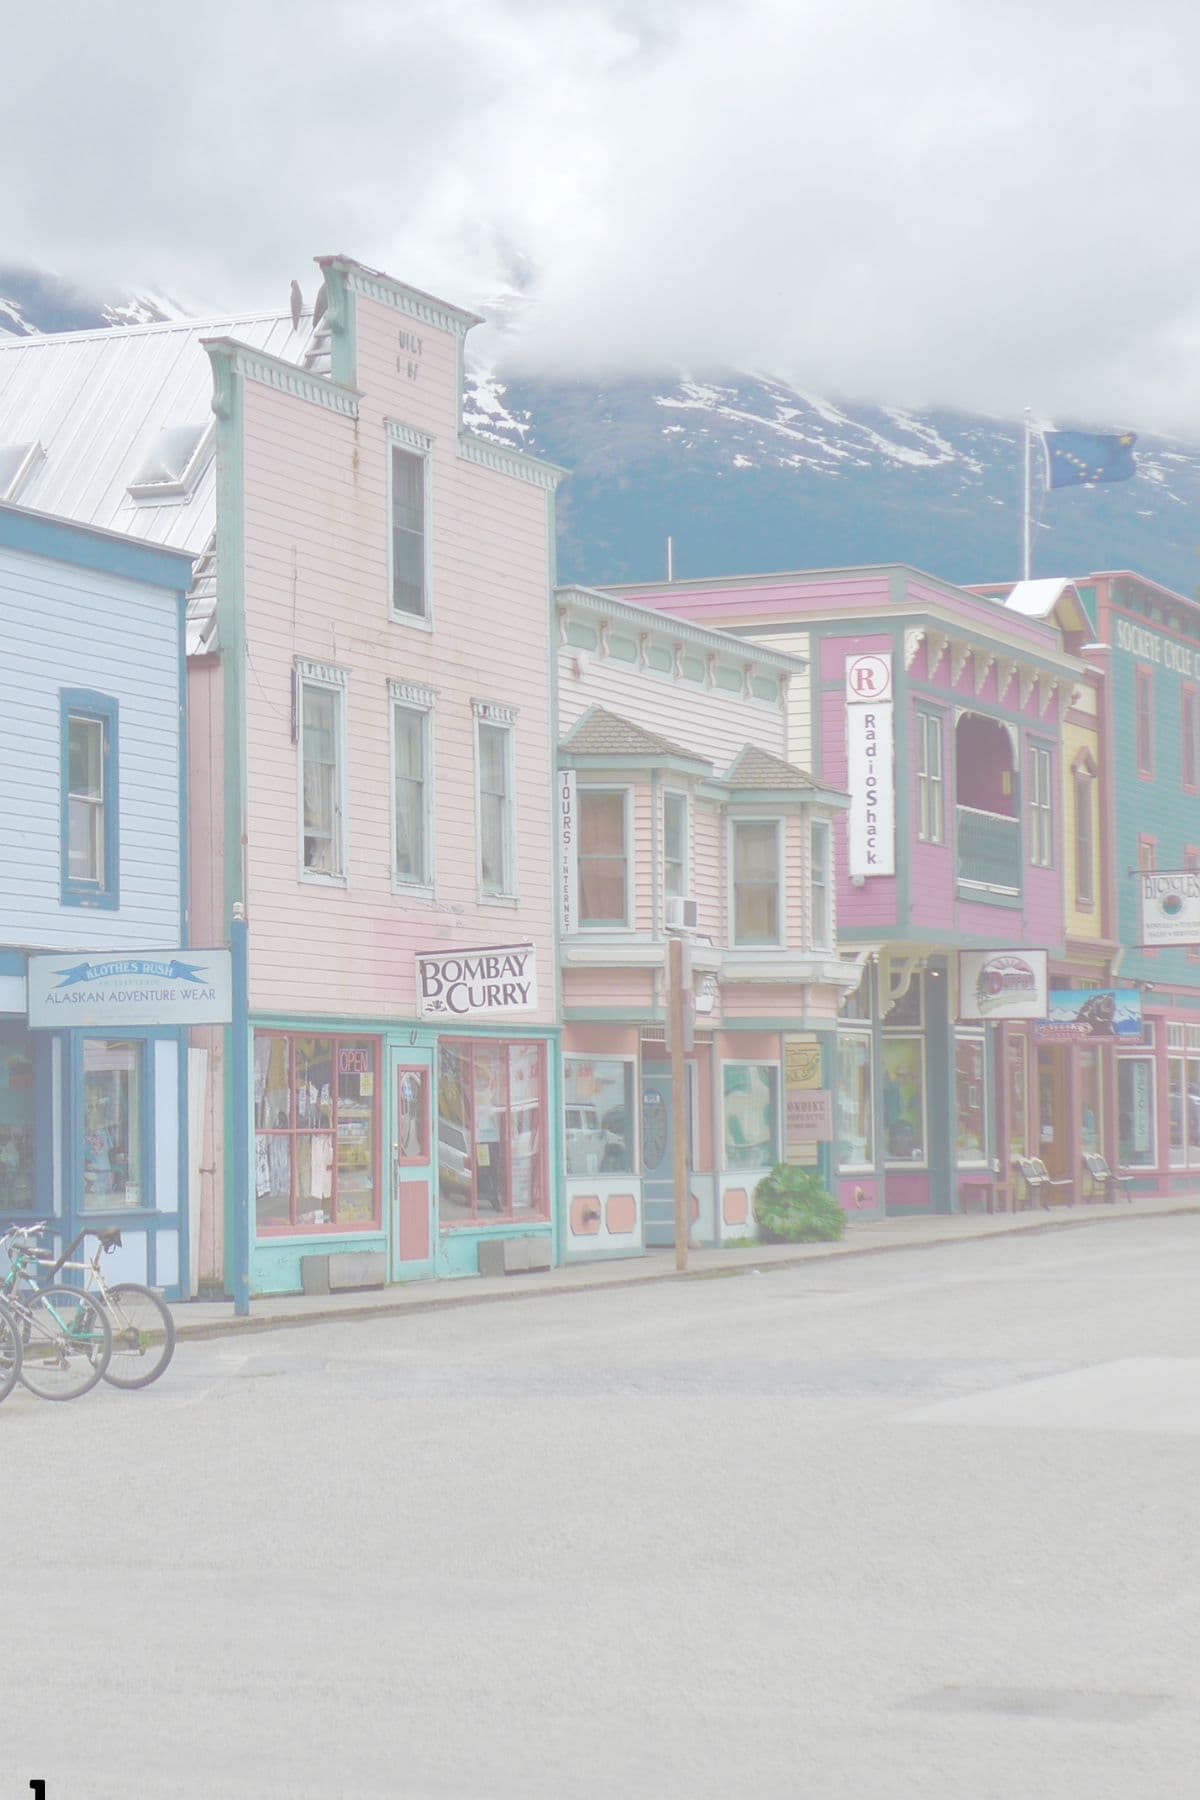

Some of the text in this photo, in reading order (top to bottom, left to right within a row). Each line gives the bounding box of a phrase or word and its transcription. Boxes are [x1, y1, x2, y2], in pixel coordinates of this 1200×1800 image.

[854, 668, 876, 690] R
[864, 714, 878, 864] RadioShack
[561, 772, 572, 844] TOURS
[86, 962, 173, 979] KLOTHES RUSH
[419, 954, 528, 997] BOMBAY
[45, 988, 216, 1004] ALASKAN ADVENTURE WEAR
[446, 982, 531, 1013] CURRY
[340, 1051, 369, 1072] OPEN
